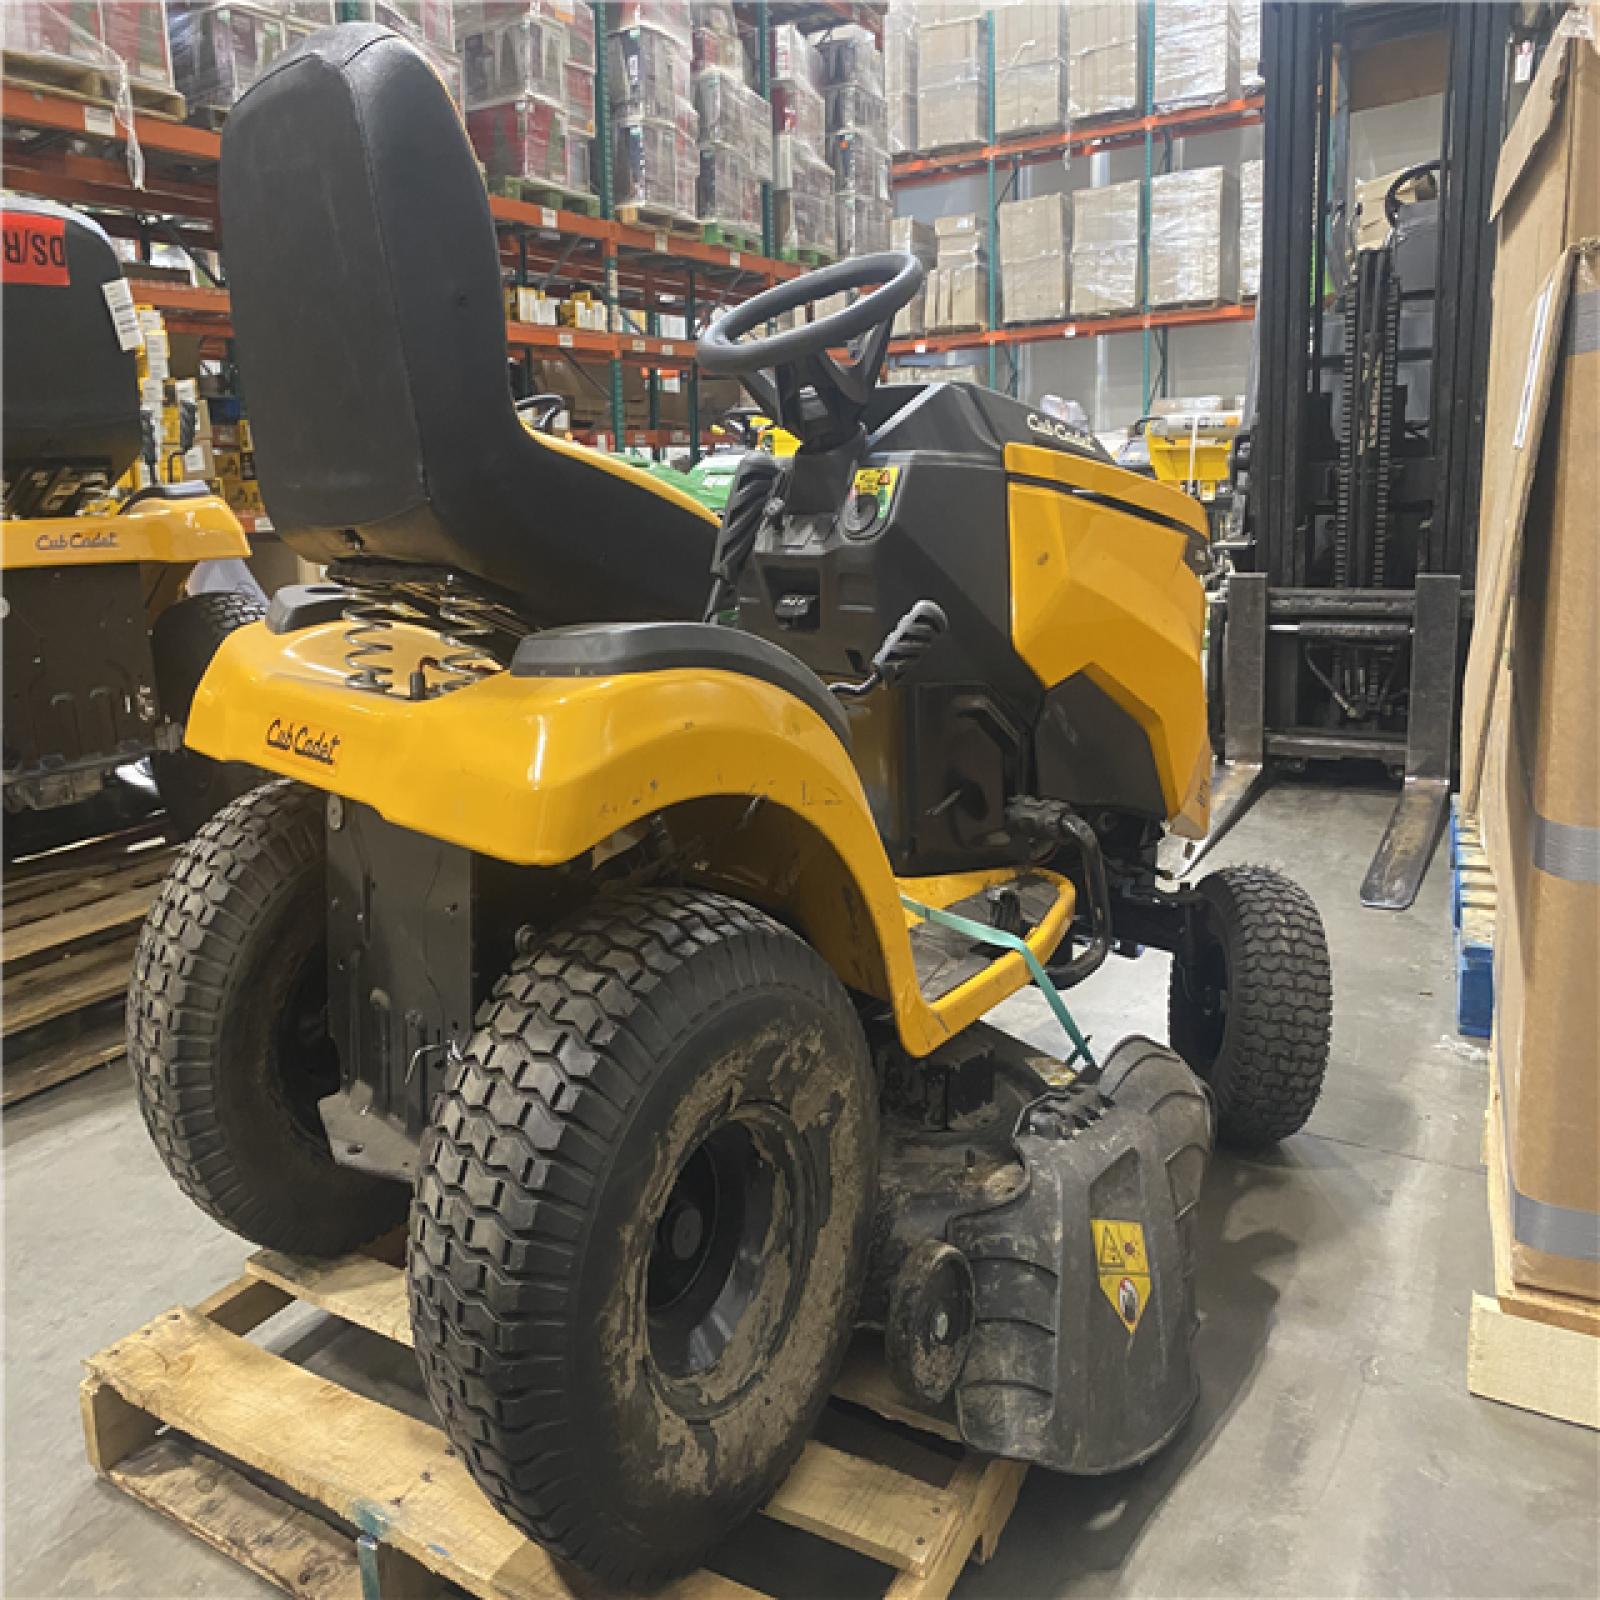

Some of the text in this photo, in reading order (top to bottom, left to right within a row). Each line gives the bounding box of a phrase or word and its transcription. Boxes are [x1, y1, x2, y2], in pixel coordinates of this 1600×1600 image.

[35, 531, 119, 551] Cub Cadet
[267, 718, 341, 766] Cub Cadet
